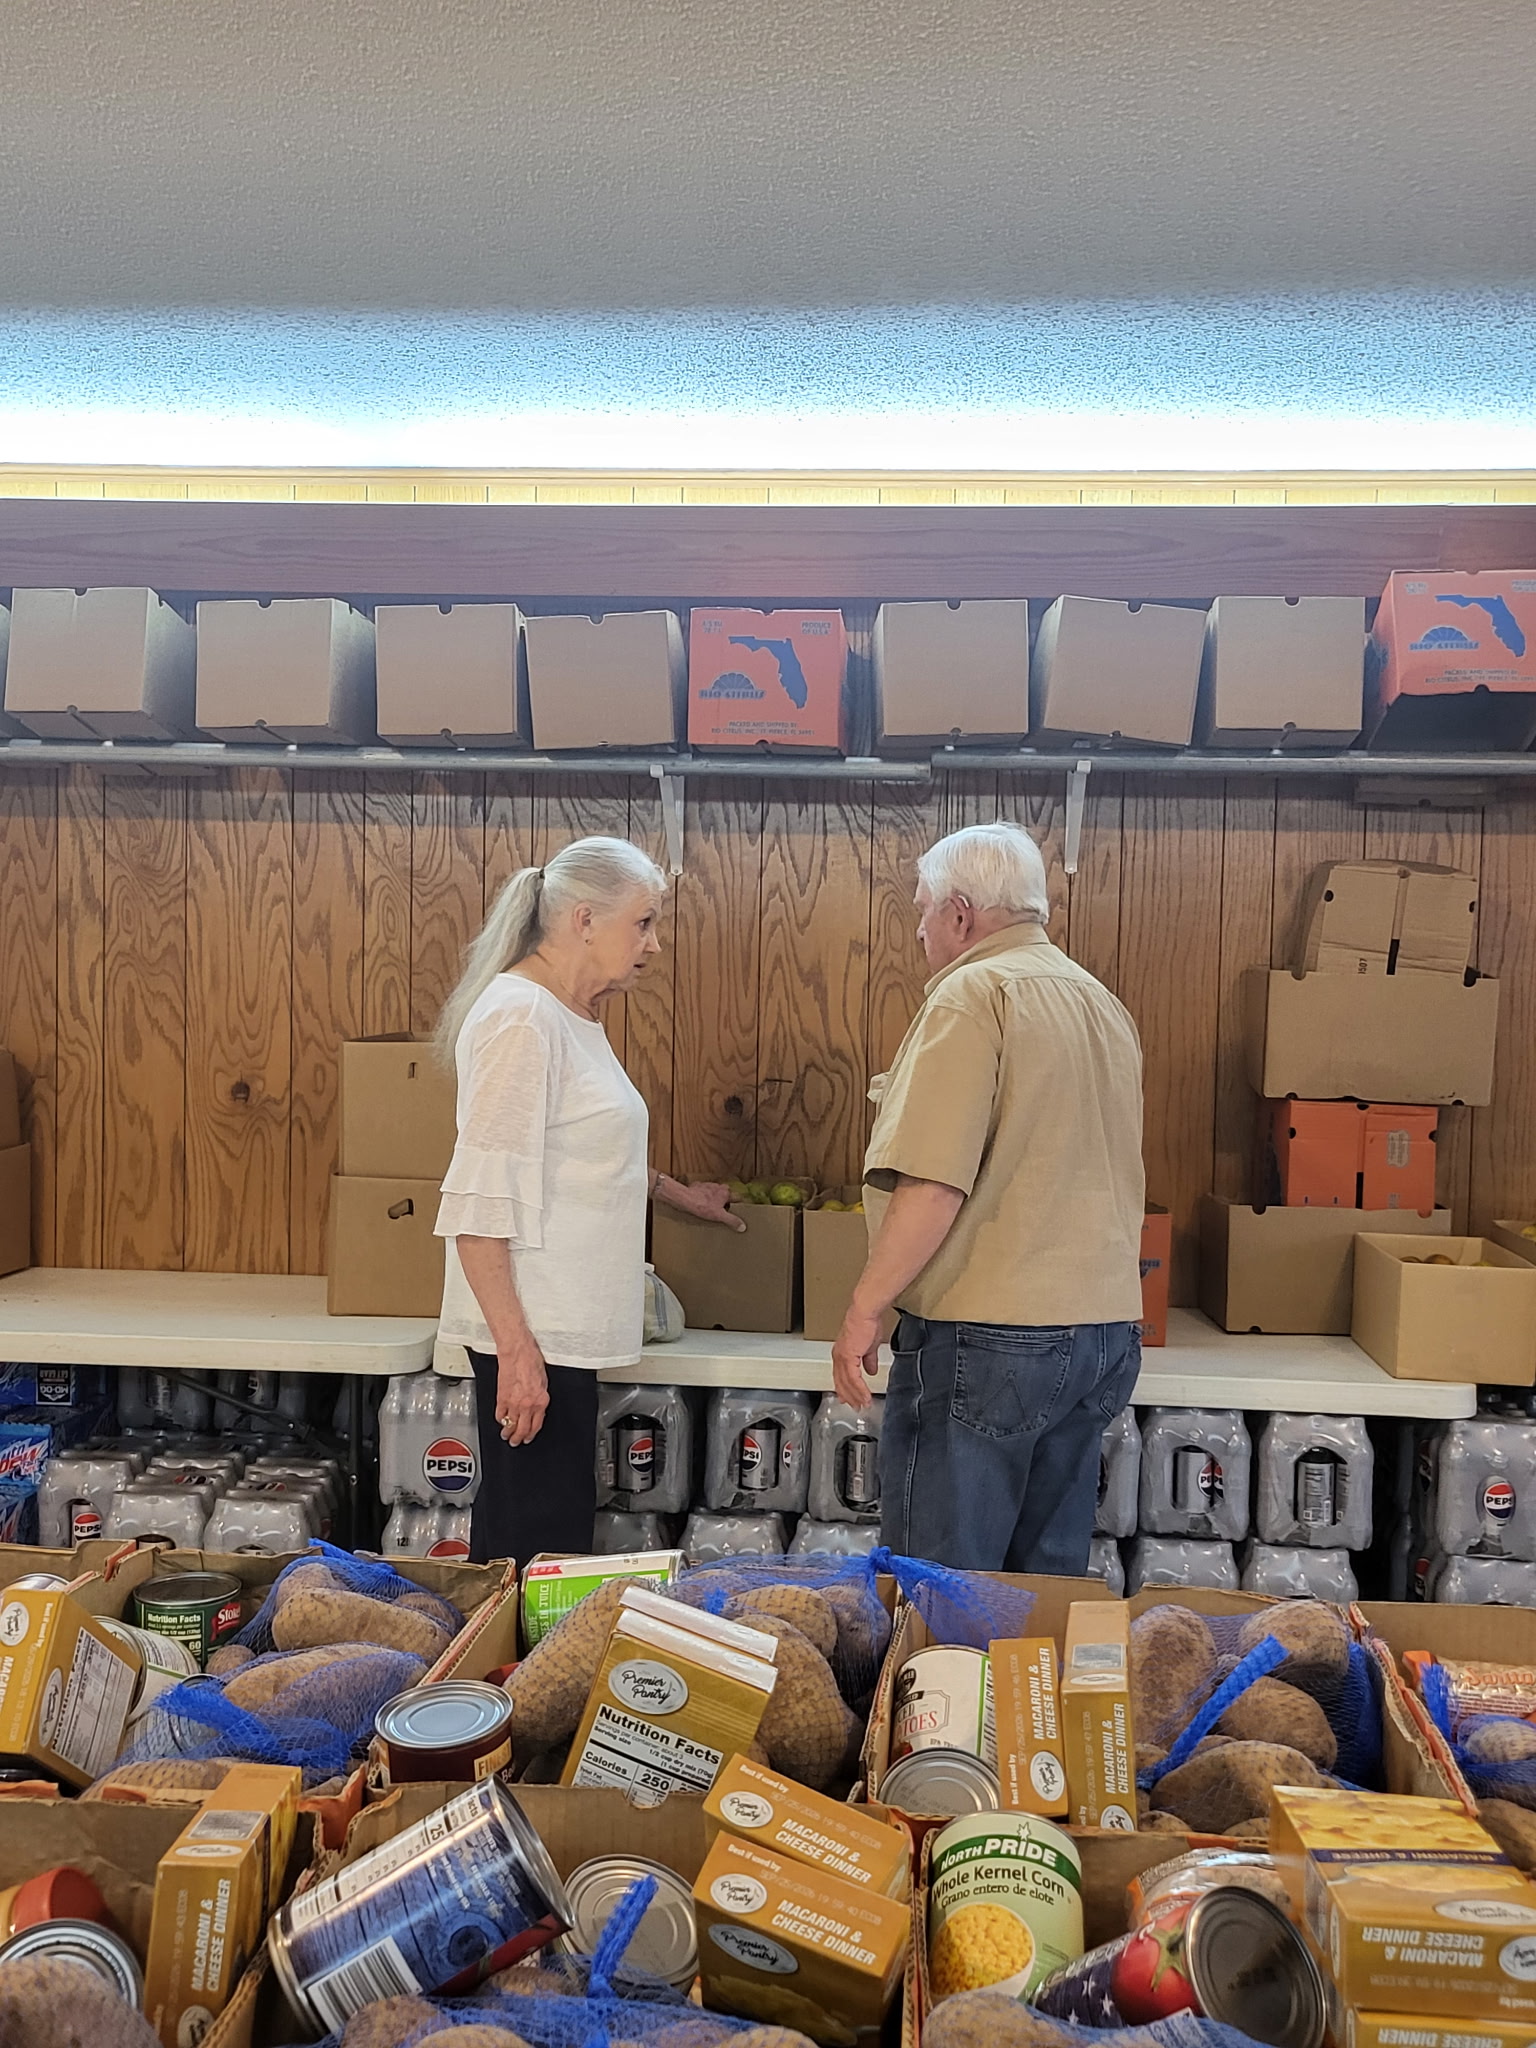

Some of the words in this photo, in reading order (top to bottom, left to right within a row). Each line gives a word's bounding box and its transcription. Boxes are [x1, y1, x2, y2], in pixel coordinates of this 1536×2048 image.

[427, 1460, 472, 1473] PEPSI
[744, 1451, 759, 1459] PSI
[1486, 1496, 1513, 1506] PEPS
[74, 1525, 101, 1533] PEPS
[539, 1583, 550, 1608] JUICE
[148, 1613, 177, 1623] Nutrition
[180, 1614, 201, 1623] Facts
[189, 1641, 200, 1650] 60
[622, 1669, 666, 1687] Premier
[1028, 1664, 1039, 1673] &
[1039, 1647, 1052, 1692] DINNER
[632, 1683, 672, 1704] Pantry
[1028, 1676, 1045, 1740] MACARONI
[1041, 1695, 1057, 1739] CHEESE
[600, 1706, 670, 1745] Nutrition
[675, 1738, 720, 1765] Facts
[1102, 1720, 1113, 1729] &
[1113, 1703, 1127, 1747] DINNER
[585, 1751, 627, 1775] Calories
[672, 1758, 685, 1768] dry
[1102, 1730, 1116, 1794] MACARONI
[1115, 1750, 1128, 1794] CHEESE
[641, 1773, 670, 1790] 250
[739, 1763, 758, 1778] Best
[760, 1775, 780, 1789] used
[777, 1783, 790, 1795] by
[430, 1823, 444, 1841] 25
[782, 1819, 850, 1856] MACARONI
[848, 1851, 860, 1863] &
[728, 1844, 744, 1858] Best
[750, 1853, 770, 1868] used
[768, 1861, 783, 1874] by
[775, 1830, 825, 1860] CHEESE
[823, 1853, 872, 1883] DINNER
[941, 1845, 983, 1872] NORTH
[984, 1838, 1057, 1867] PRIDE
[933, 1870, 970, 1902] Whole
[974, 1865, 1028, 1882] Kernel
[1032, 1870, 1064, 1898] Corn
[201, 1898, 214, 1911] &
[214, 1879, 231, 1934] DINNER
[941, 1887, 970, 1909] Grano
[973, 1883, 1010, 1895] entero
[1013, 1883, 1026, 1896] de
[1030, 1888, 1055, 1906] elote
[777, 1900, 850, 1937] MACARONI
[850, 1931, 863, 1943] &
[772, 1914, 824, 1943] CHEESE
[824, 1936, 876, 1965] DINNER
[1362, 1926, 1420, 1944] DINNER
[1425, 1931, 1485, 1950] CHEESE
[192, 1913, 211, 1991] MACARONI
[207, 1936, 225, 1992] CHEESE
[1385, 1946, 1396, 1960] &
[1400, 1948, 1483, 1968] MACARONI
[1378, 2027, 1438, 2048] DINNER
[1444, 2032, 1503, 2048] CHEESE
